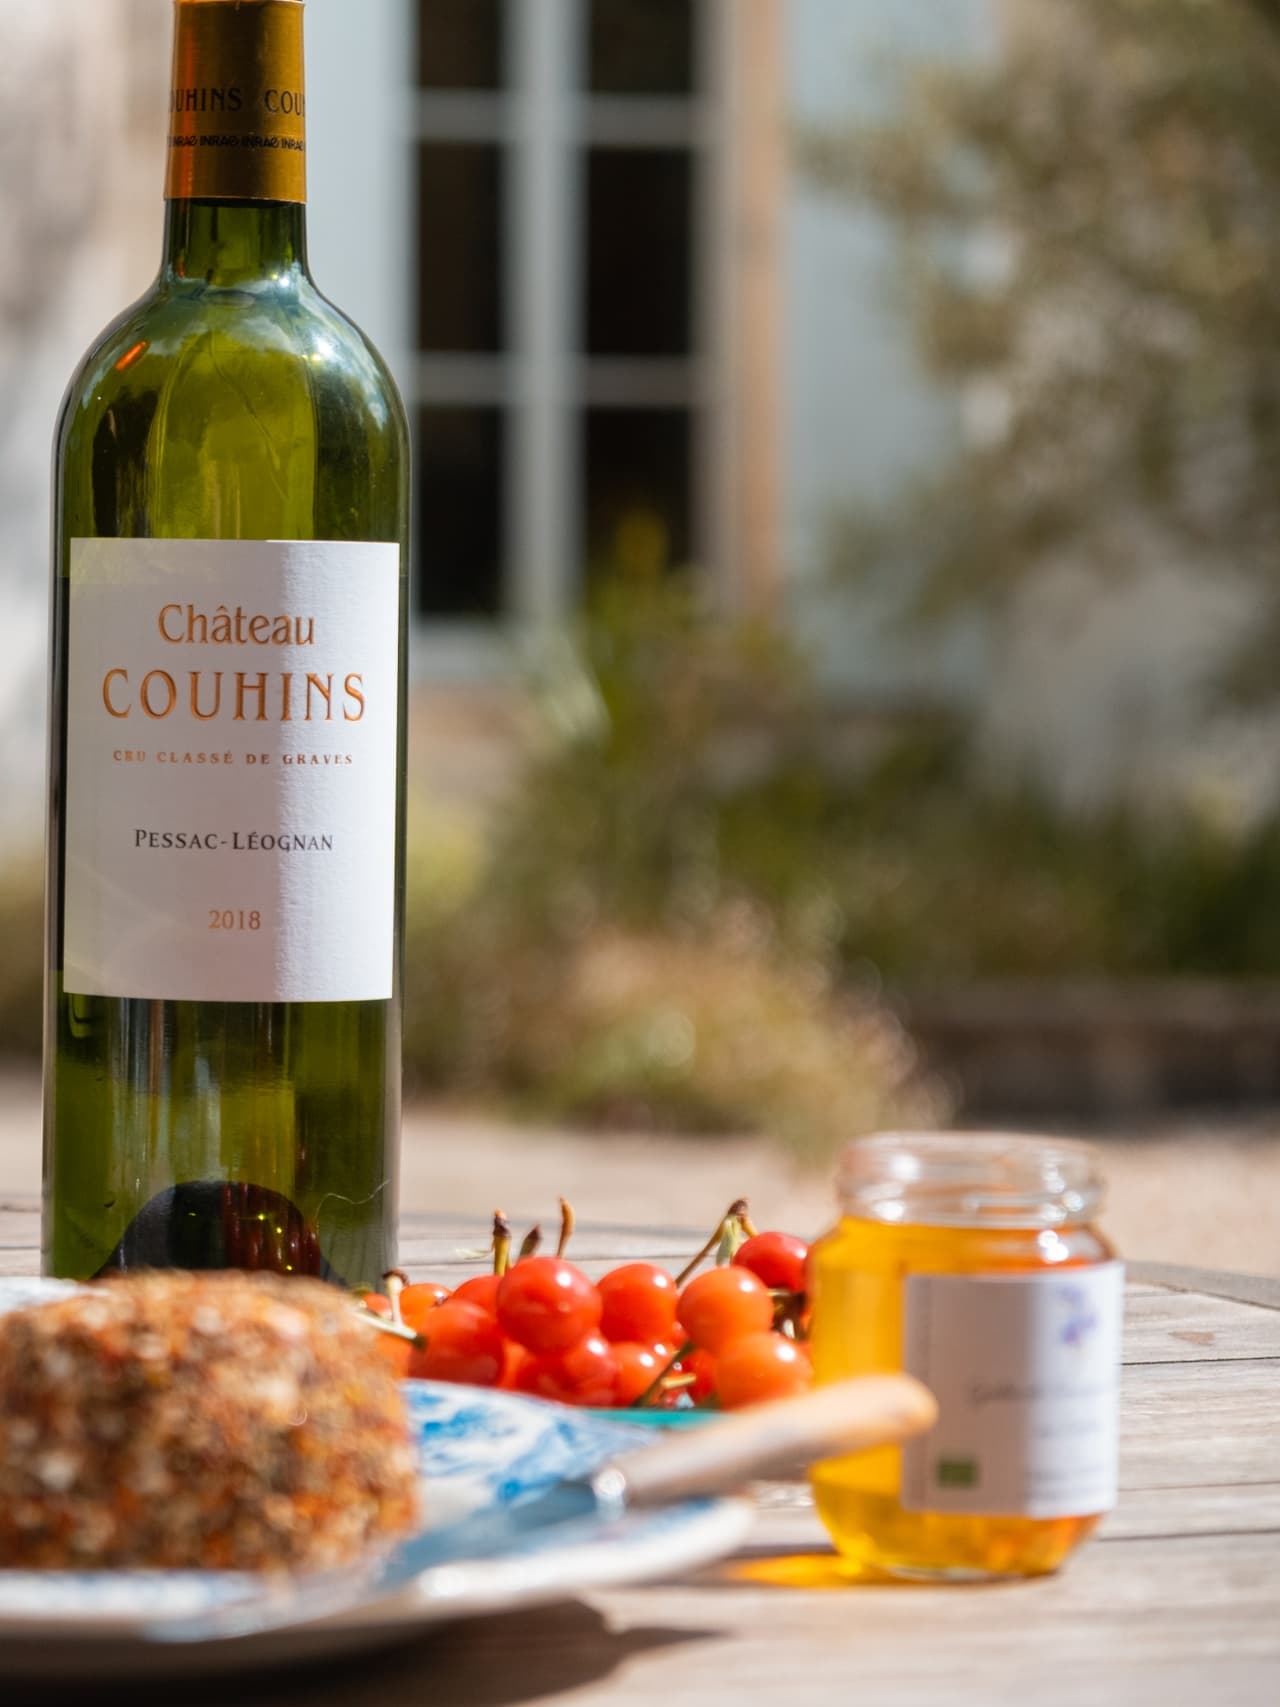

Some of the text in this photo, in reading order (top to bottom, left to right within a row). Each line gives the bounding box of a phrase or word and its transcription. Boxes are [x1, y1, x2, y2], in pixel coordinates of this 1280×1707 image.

[170, 87, 242, 113] UHINS
[264, 89, 305, 116] COU
[158, 604, 315, 646] Château
[102, 667, 366, 721] COUHINS
[113, 750, 352, 765] CRU CLASSÉ DE GRAVES
[208, 911, 261, 930] 2018
